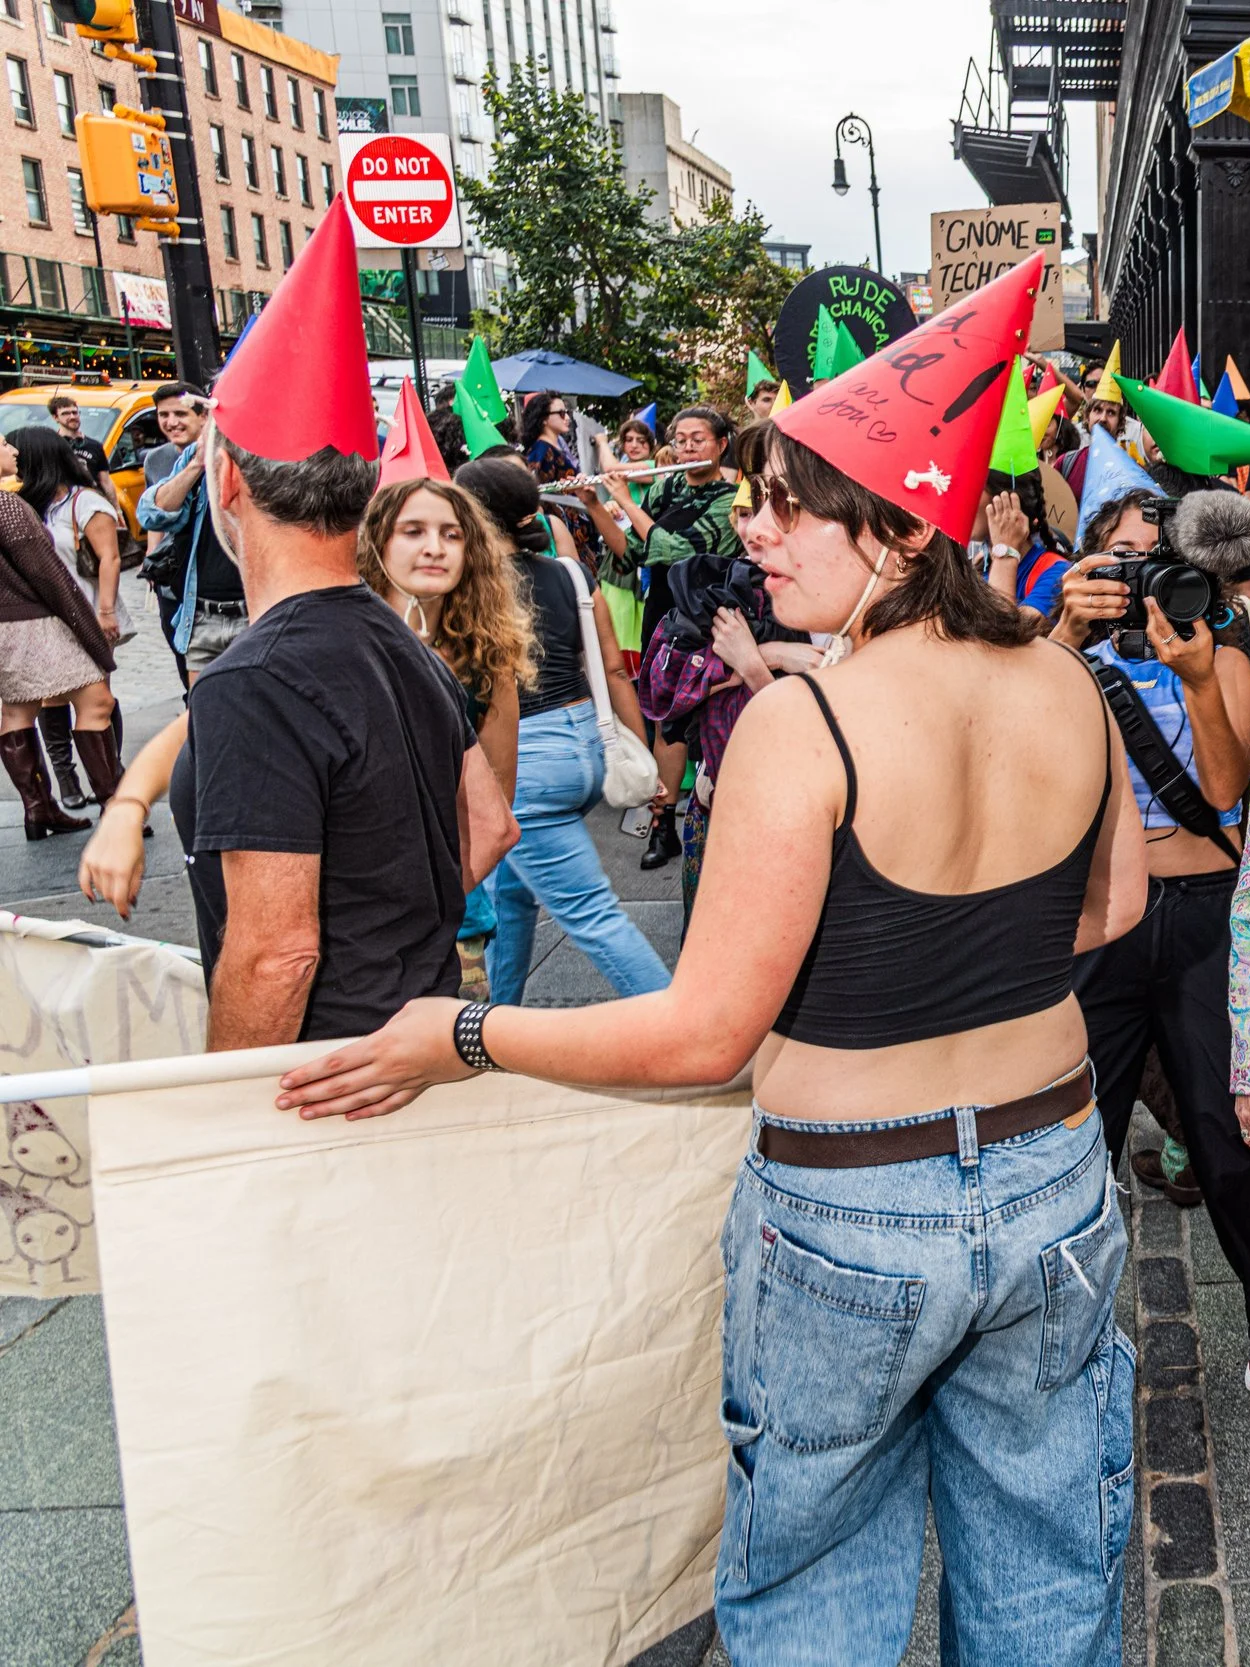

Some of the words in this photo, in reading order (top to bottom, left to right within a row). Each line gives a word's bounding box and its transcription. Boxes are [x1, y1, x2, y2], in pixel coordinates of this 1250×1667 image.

[337, 119, 371, 131] OHLER
[362, 157, 388, 175] DO
[394, 156, 430, 175] NOT
[373, 205, 433, 224] ENTER
[946, 219, 1030, 253] GNOME
[828, 275, 897, 314] RUDE
[829, 300, 890, 353] CHANICA
